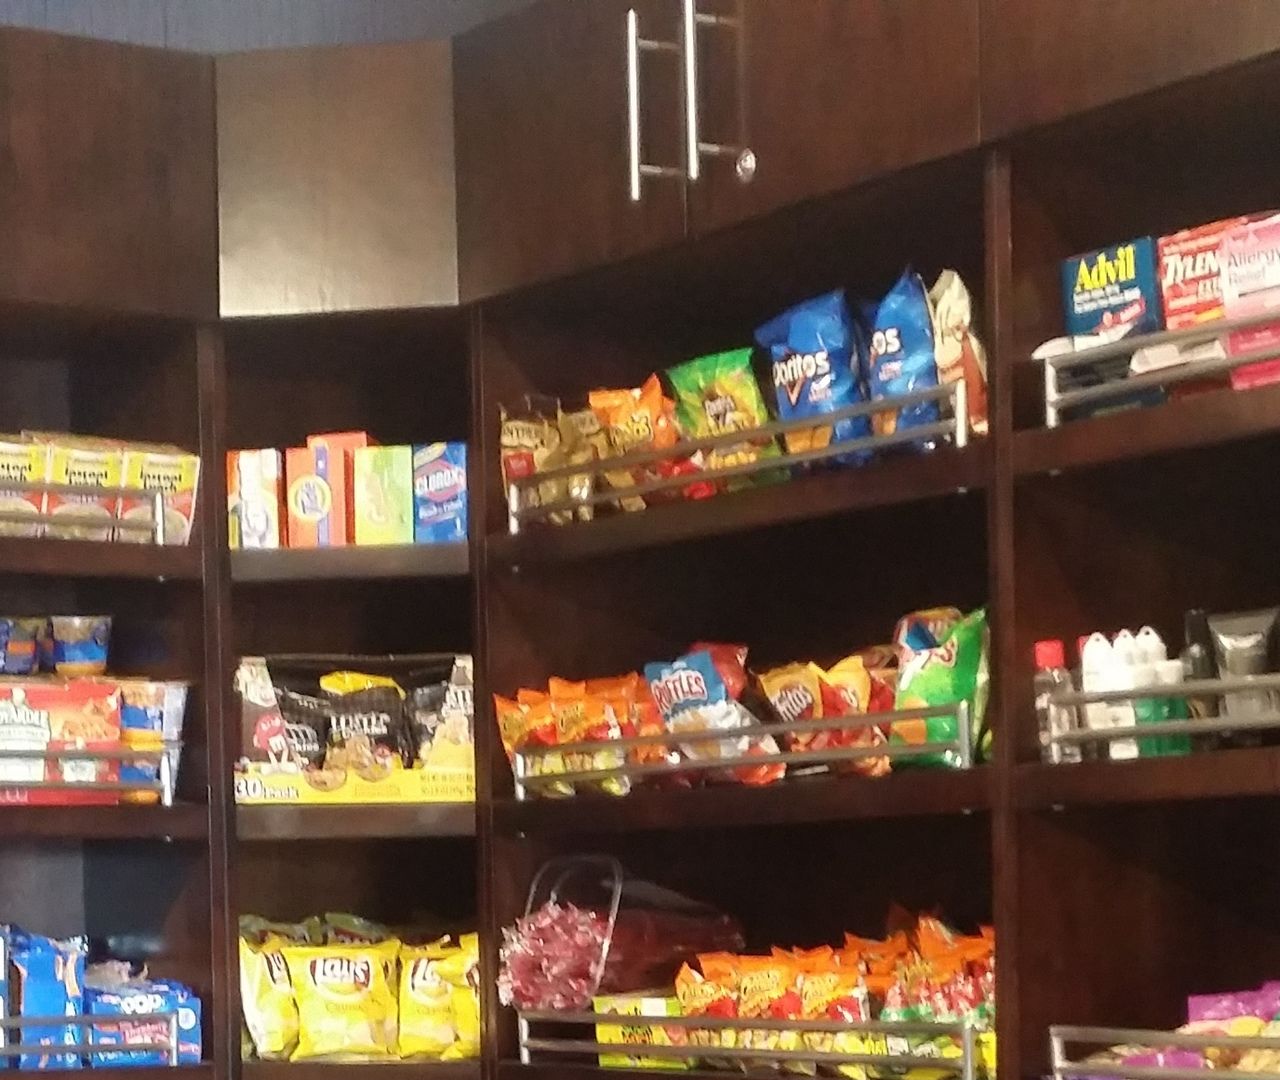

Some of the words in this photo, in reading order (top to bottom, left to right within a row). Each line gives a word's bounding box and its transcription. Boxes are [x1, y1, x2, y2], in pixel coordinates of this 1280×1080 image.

[1074, 243, 1136, 293] Advil
[1164, 250, 1221, 287] TYLEN
[772, 350, 830, 388] Doritos
[415, 468, 468, 496] CLOROX
[651, 672, 706, 712] RUFFLES
